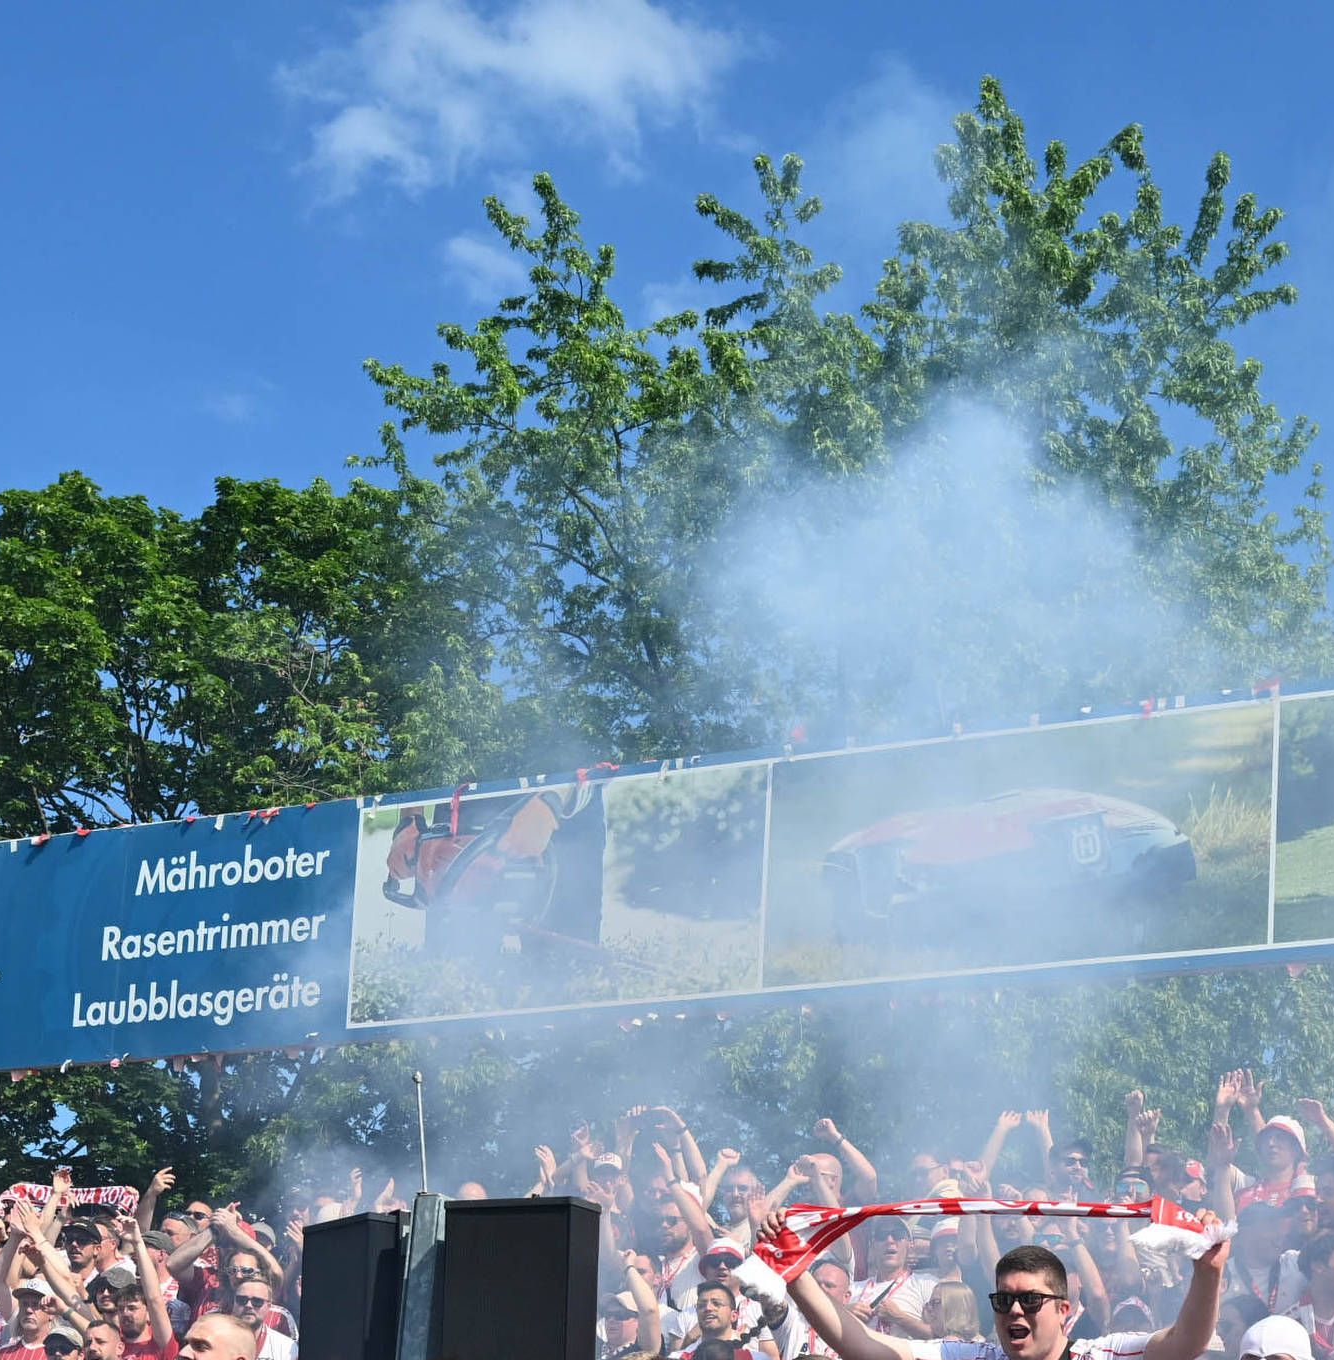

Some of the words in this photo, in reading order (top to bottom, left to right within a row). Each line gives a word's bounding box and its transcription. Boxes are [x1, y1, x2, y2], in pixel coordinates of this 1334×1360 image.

[135, 843, 330, 898] Mähroboter
[100, 910, 327, 962] Rasentrimmer
[72, 972, 321, 1029] Laubblasgeräte
